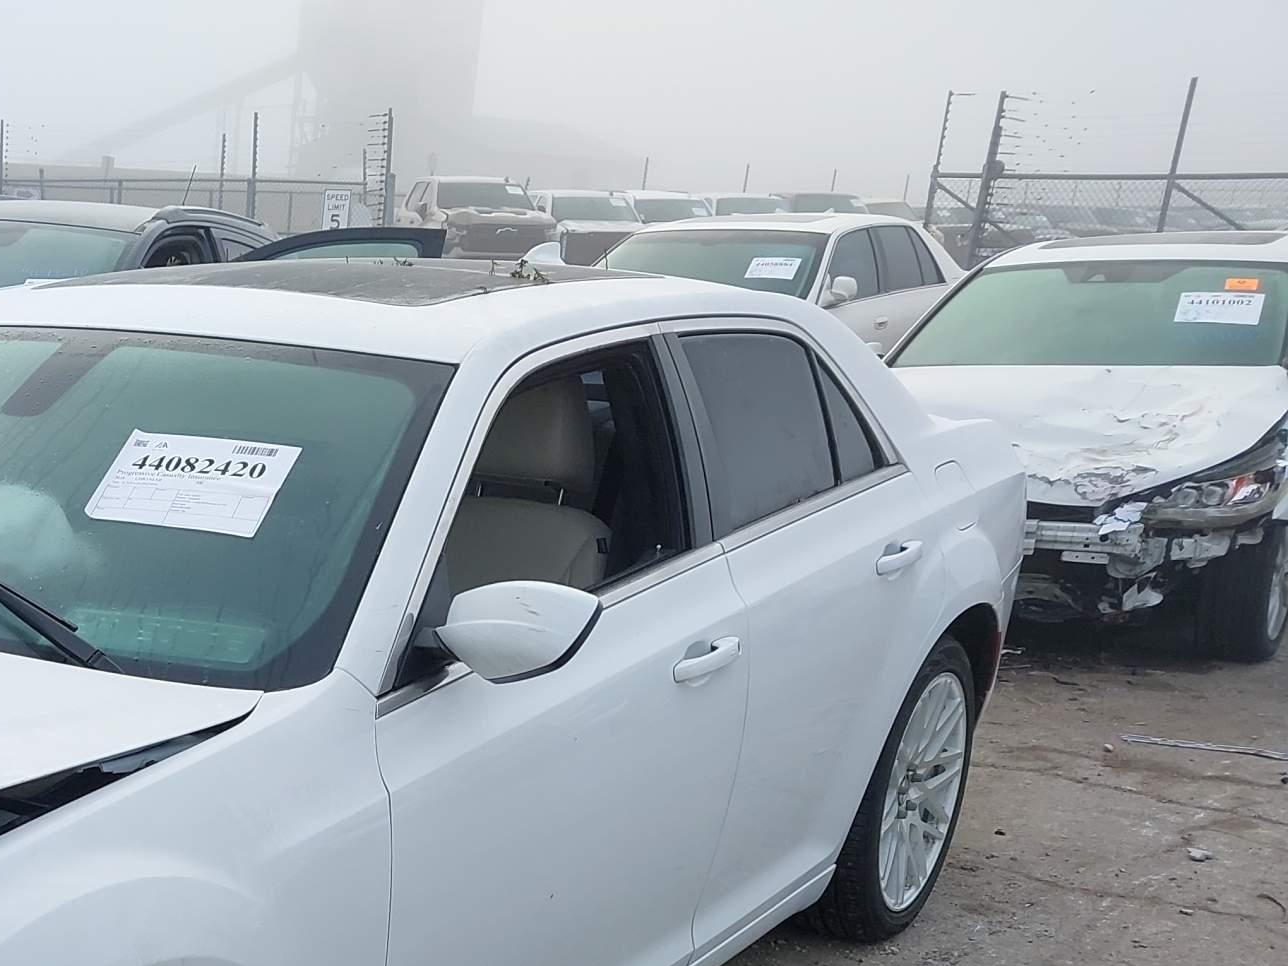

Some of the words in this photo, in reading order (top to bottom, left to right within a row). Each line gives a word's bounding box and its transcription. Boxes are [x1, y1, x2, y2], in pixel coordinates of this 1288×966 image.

[330, 214, 340, 229] 5
[116, 468, 156, 478] Progressive
[157, 470, 185, 479] Casualty
[132, 455, 267, 479] 44082420
